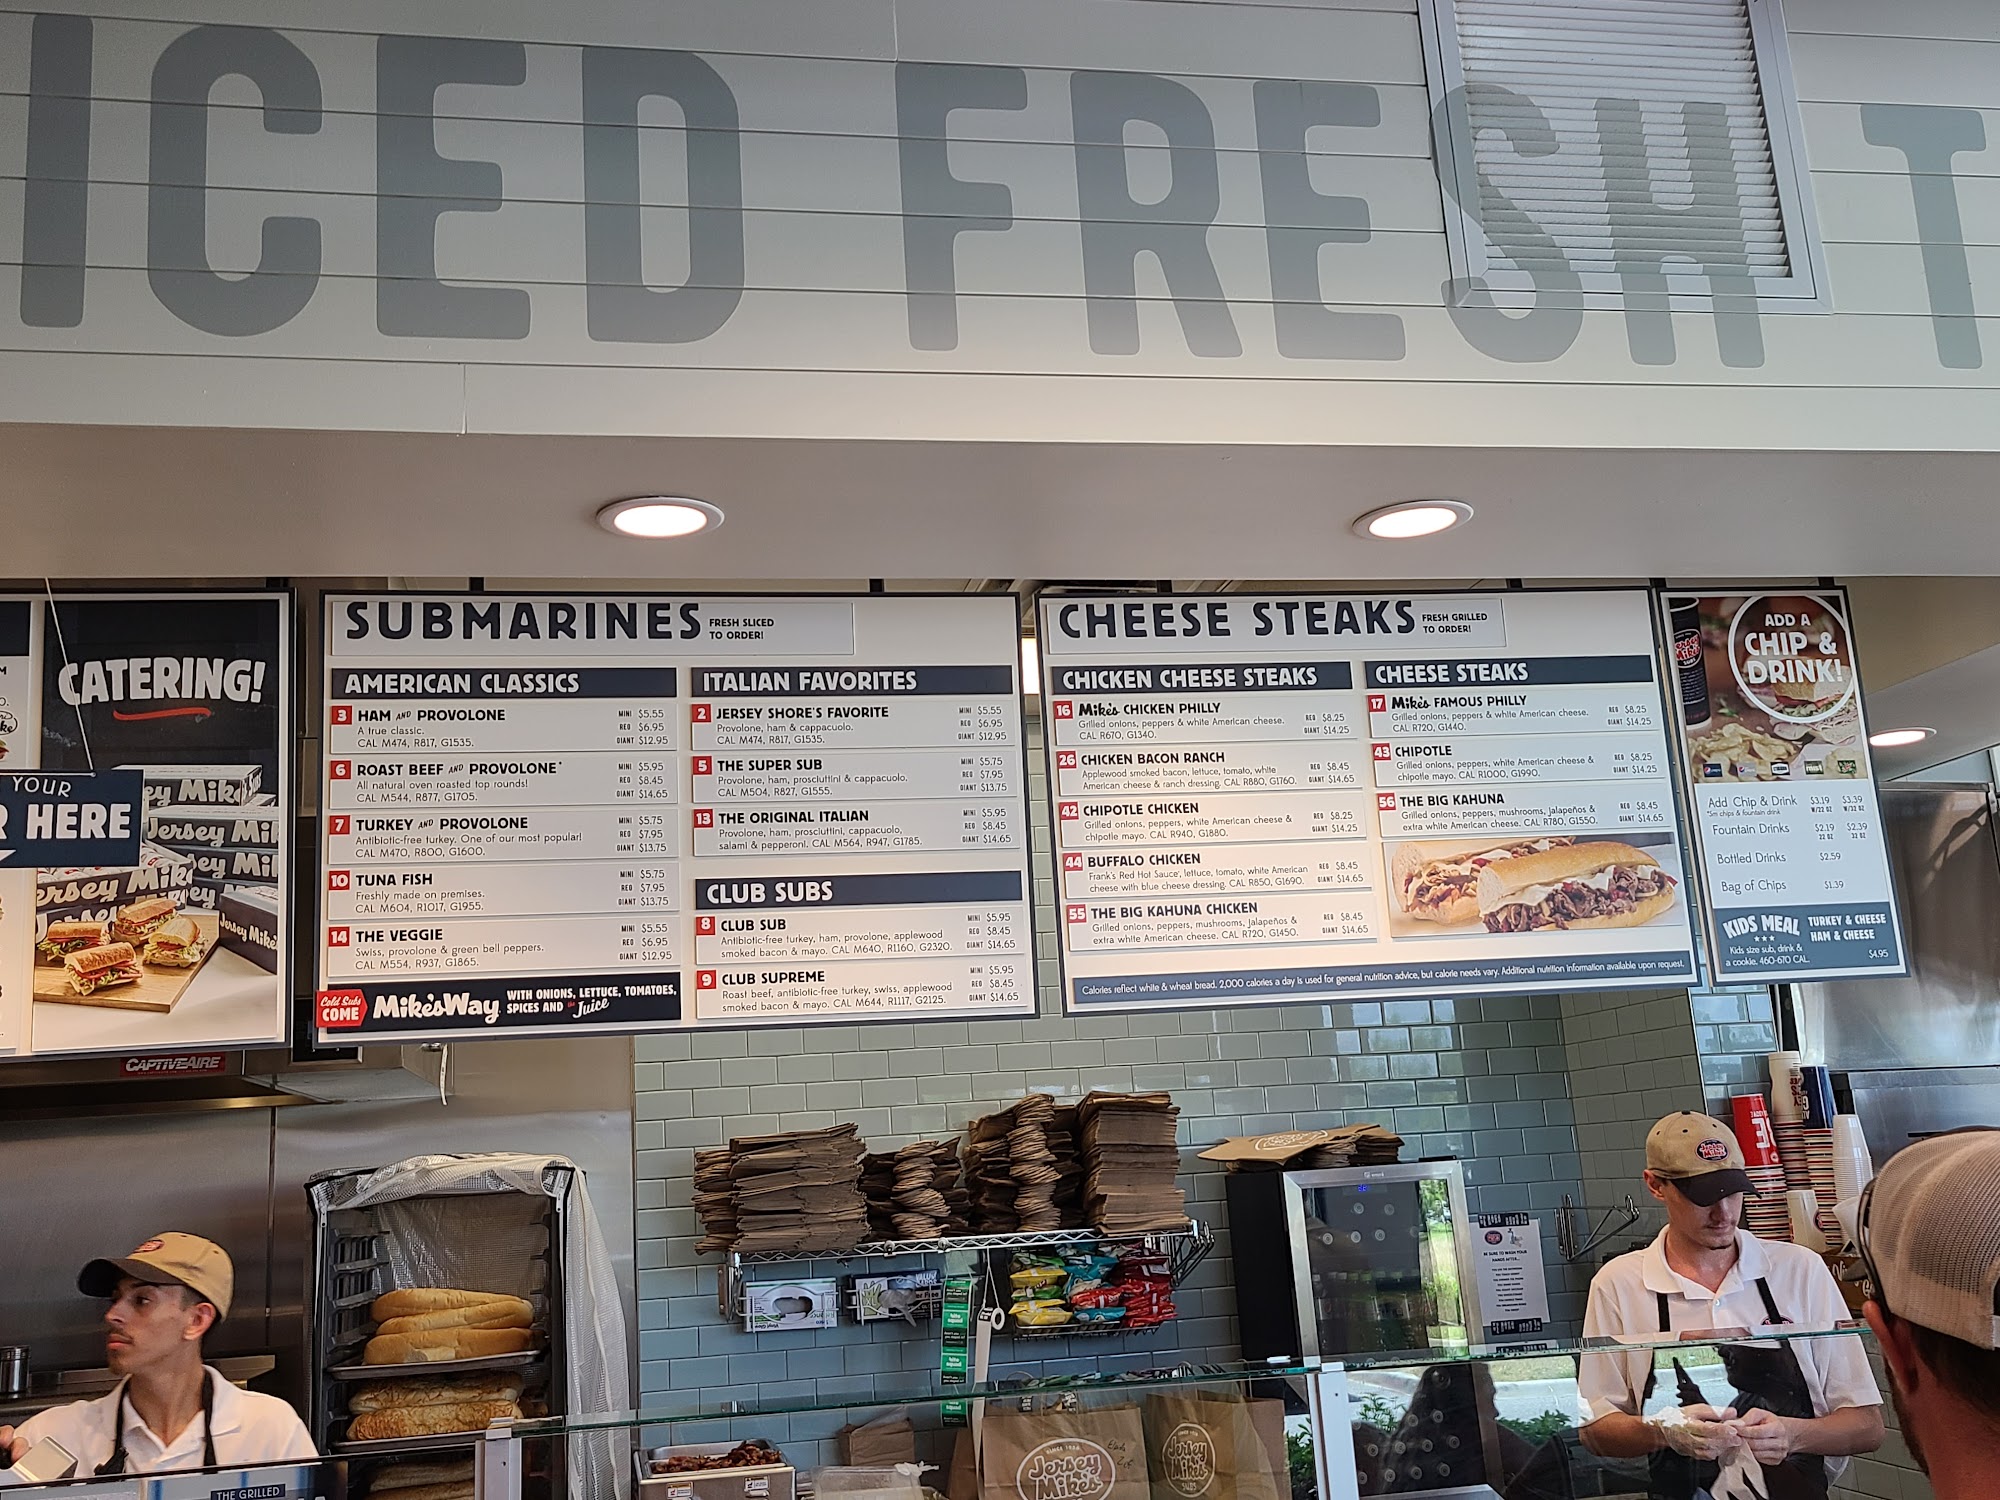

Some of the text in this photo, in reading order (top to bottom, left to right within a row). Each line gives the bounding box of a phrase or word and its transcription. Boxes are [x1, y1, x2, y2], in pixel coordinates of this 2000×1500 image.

[19, 11, 1987, 369] ICED FRESH T
[346, 601, 702, 640] SUBMARINES
[742, 618, 774, 626] SLICED
[1059, 600, 1416, 638] CHEESE STEAKS
[1422, 613, 1488, 622] FRESH GRILLED
[1765, 614, 1811, 626] ADD A
[710, 631, 764, 639] TO ORDER!
[1423, 625, 1471, 633] TO ORDER!
[1745, 632, 1836, 656] CHIP &
[1375, 662, 1528, 684] CHEESE STEAKS
[1747, 659, 1842, 684] DRINK!
[58, 657, 265, 705] CATERING!
[345, 673, 580, 694] AMERICAN CLASSICS
[704, 671, 917, 691] ITALIAN FAVORITES
[1063, 667, 1317, 690] CHICKEN CHEESE STEAKS
[1371, 695, 1526, 709] 17 Mike's FAMOUS PHILLY
[337, 709, 505, 722] 3 HAM AND PROVOLONE
[639, 709, 664, 718] $5.55
[697, 707, 889, 719] 2 JERSEY SHORE'S FAVORITE
[1056, 702, 1221, 717] 16 Mike's CHICKEN PHILLY
[367, 726, 388, 735] true
[391, 726, 424, 735] classic.
[639, 723, 665, 732] $6.95
[717, 723, 764, 734] Provolone,
[767, 723, 786, 732] ham
[790, 723, 796, 731] &
[358, 738, 474, 749] CAL M474, R817, G1535.
[639, 736, 668, 746] $12.95
[336, 765, 346, 775] 6
[358, 764, 403, 776] ROAST
[409, 764, 444, 775] BEEF
[449, 764, 464, 774] AND
[698, 759, 822, 771] 5 THE SUPER SUB
[12, 775, 71, 797] YOUR
[1378, 793, 1504, 807] 56 THE BIG KAHUNA
[1709, 797, 1727, 808] Add
[1733, 797, 1757, 810] Chip
[1760, 797, 1768, 806] &
[1772, 795, 1798, 806] Drink
[1843, 796, 1862, 804] $3.39
[26, 803, 132, 840] HERE
[335, 818, 528, 831] 7 TURKEY AND PROVOLONE
[1718, 852, 1841, 864] Bottled Drinks $2.59
[330, 874, 432, 887] 10 TUNA FISH
[1722, 879, 1844, 894] Bag of Chips $1.39
[356, 890, 485, 902] Freshly made on premises.
[707, 881, 833, 904] CLUB SUBS
[220, 913, 247, 941] Jersey
[702, 918, 786, 931] 8 CLUB SUB
[1722, 914, 1800, 939] KIDS MEAL
[1808, 914, 1886, 927] TURKEY & CHEESE
[330, 929, 443, 943] 14 THE VEGGIE
[1810, 929, 1875, 942] HAM & CHEESE
[507, 989, 532, 1001] WITH
[537, 988, 576, 1000] ONIONS,
[580, 987, 621, 998] LETTUCE,
[625, 985, 677, 997] TOMATOES,
[320, 996, 362, 1008] Cold Subs
[507, 1002, 538, 1014] SPICES
[543, 1002, 563, 1012] AND
[573, 997, 609, 1018] Juice
[322, 1008, 359, 1021] COME
[1168, 1437, 1207, 1461] Jersey
[1029, 1454, 1102, 1479] Jersey
[216, 1487, 280, 1500] THE GRILLED
